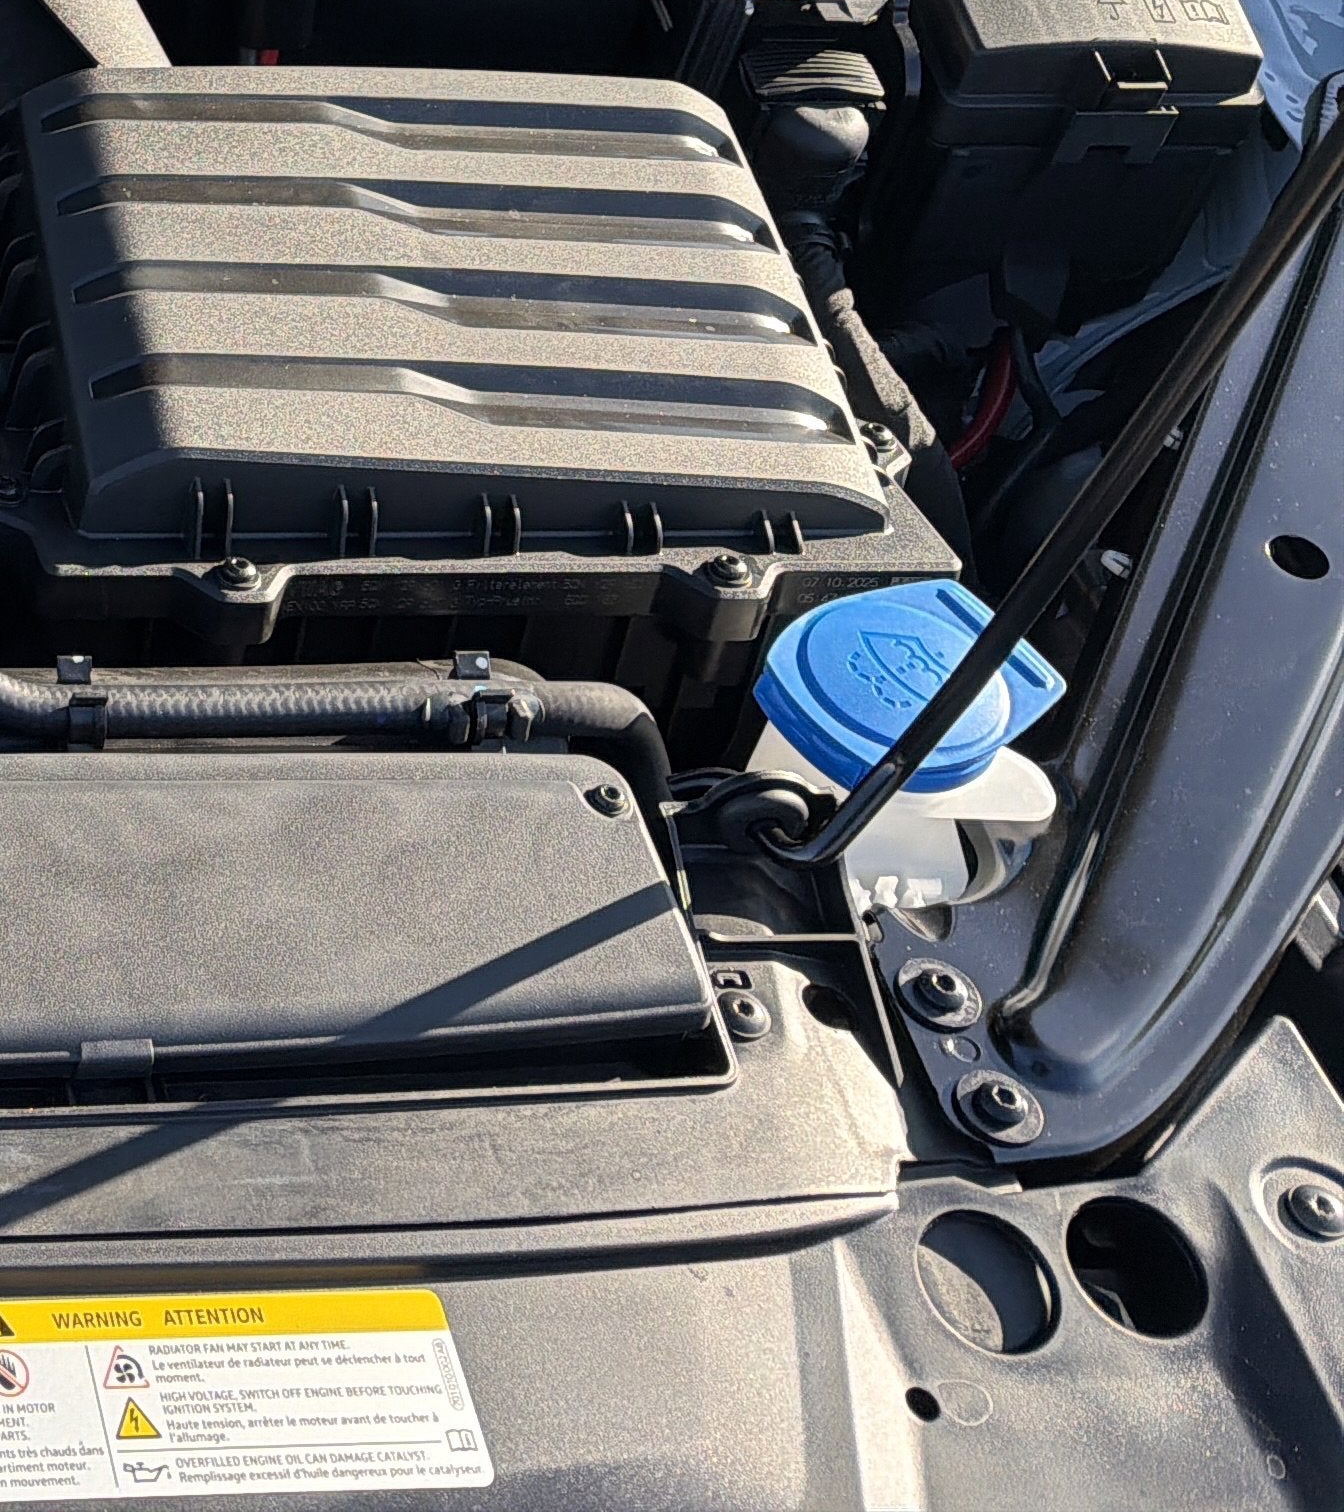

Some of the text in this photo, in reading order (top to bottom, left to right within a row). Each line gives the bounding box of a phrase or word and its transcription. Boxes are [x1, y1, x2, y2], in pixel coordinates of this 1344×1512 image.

[51, 1307, 264, 1329] WARNING ATTENTION
[149, 1343, 201, 1355] RADIATOR
[203, 1343, 224, 1354] FAN
[226, 1342, 248, 1353] MAY
[251, 1341, 281, 1353] START
[285, 1341, 297, 1351] AT
[299, 1340, 320, 1350] ANY
[152, 1360, 165, 1371] Le
[167, 1358, 225, 1370] ventilateur
[227, 1357, 241, 1368] de
[243, 1356, 291, 1368] radiateur
[294, 1355, 319, 1368] peut
[320, 1356, 332, 1366] se
[334, 1353, 392, 1365] déclencher
[403, 1353, 425, 1363] tout
[155, 1373, 206, 1384] moment.
[159, 1391, 186, 1402] HIGH
[240, 1388, 280, 1400] SWITCH
[281, 1387, 301, 1399] OFF
[304, 1386, 344, 1399] ENGINE
[346, 1385, 386, 1397] BEFORE
[387, 1384, 443, 1397] TOUCHING
[2, 1404, 14, 1415] IN
[16, 1402, 56, 1414] MOTOR
[162, 1402, 258, 1416] IGNITION SYSTEM.
[166, 1420, 199, 1431] Haute
[202, 1418, 246, 1430] tension,
[247, 1416, 284, 1428] arrêter
[286, 1416, 297, 1426] le
[299, 1416, 338, 1426] moteur
[340, 1415, 370, 1425] avant
[373, 1413, 387, 1424] de
[388, 1413, 429, 1424] toucher
[169, 1432, 231, 1444] l'allumage.
[18, 1446, 38, 1458] très
[40, 1445, 78, 1458] chauds
[79, 1444, 104, 1457] dans
[47, 1461, 92, 1472] moteur.
[175, 1456, 241, 1469] OVERFILLED
[243, 1455, 283, 1467] ENGINE
[285, 1454, 302, 1465] OIL
[304, 1452, 328, 1464] CAN
[329, 1451, 375, 1464] DAMAGE
[10, 1475, 80, 1488] mouvement.
[178, 1470, 247, 1485] Remplissage
[249, 1467, 291, 1480] excessif
[293, 1466, 330, 1480] d'huile
[331, 1467, 388, 1480] dangereux
[389, 1466, 414, 1478] pour
[415, 1464, 427, 1476] le
